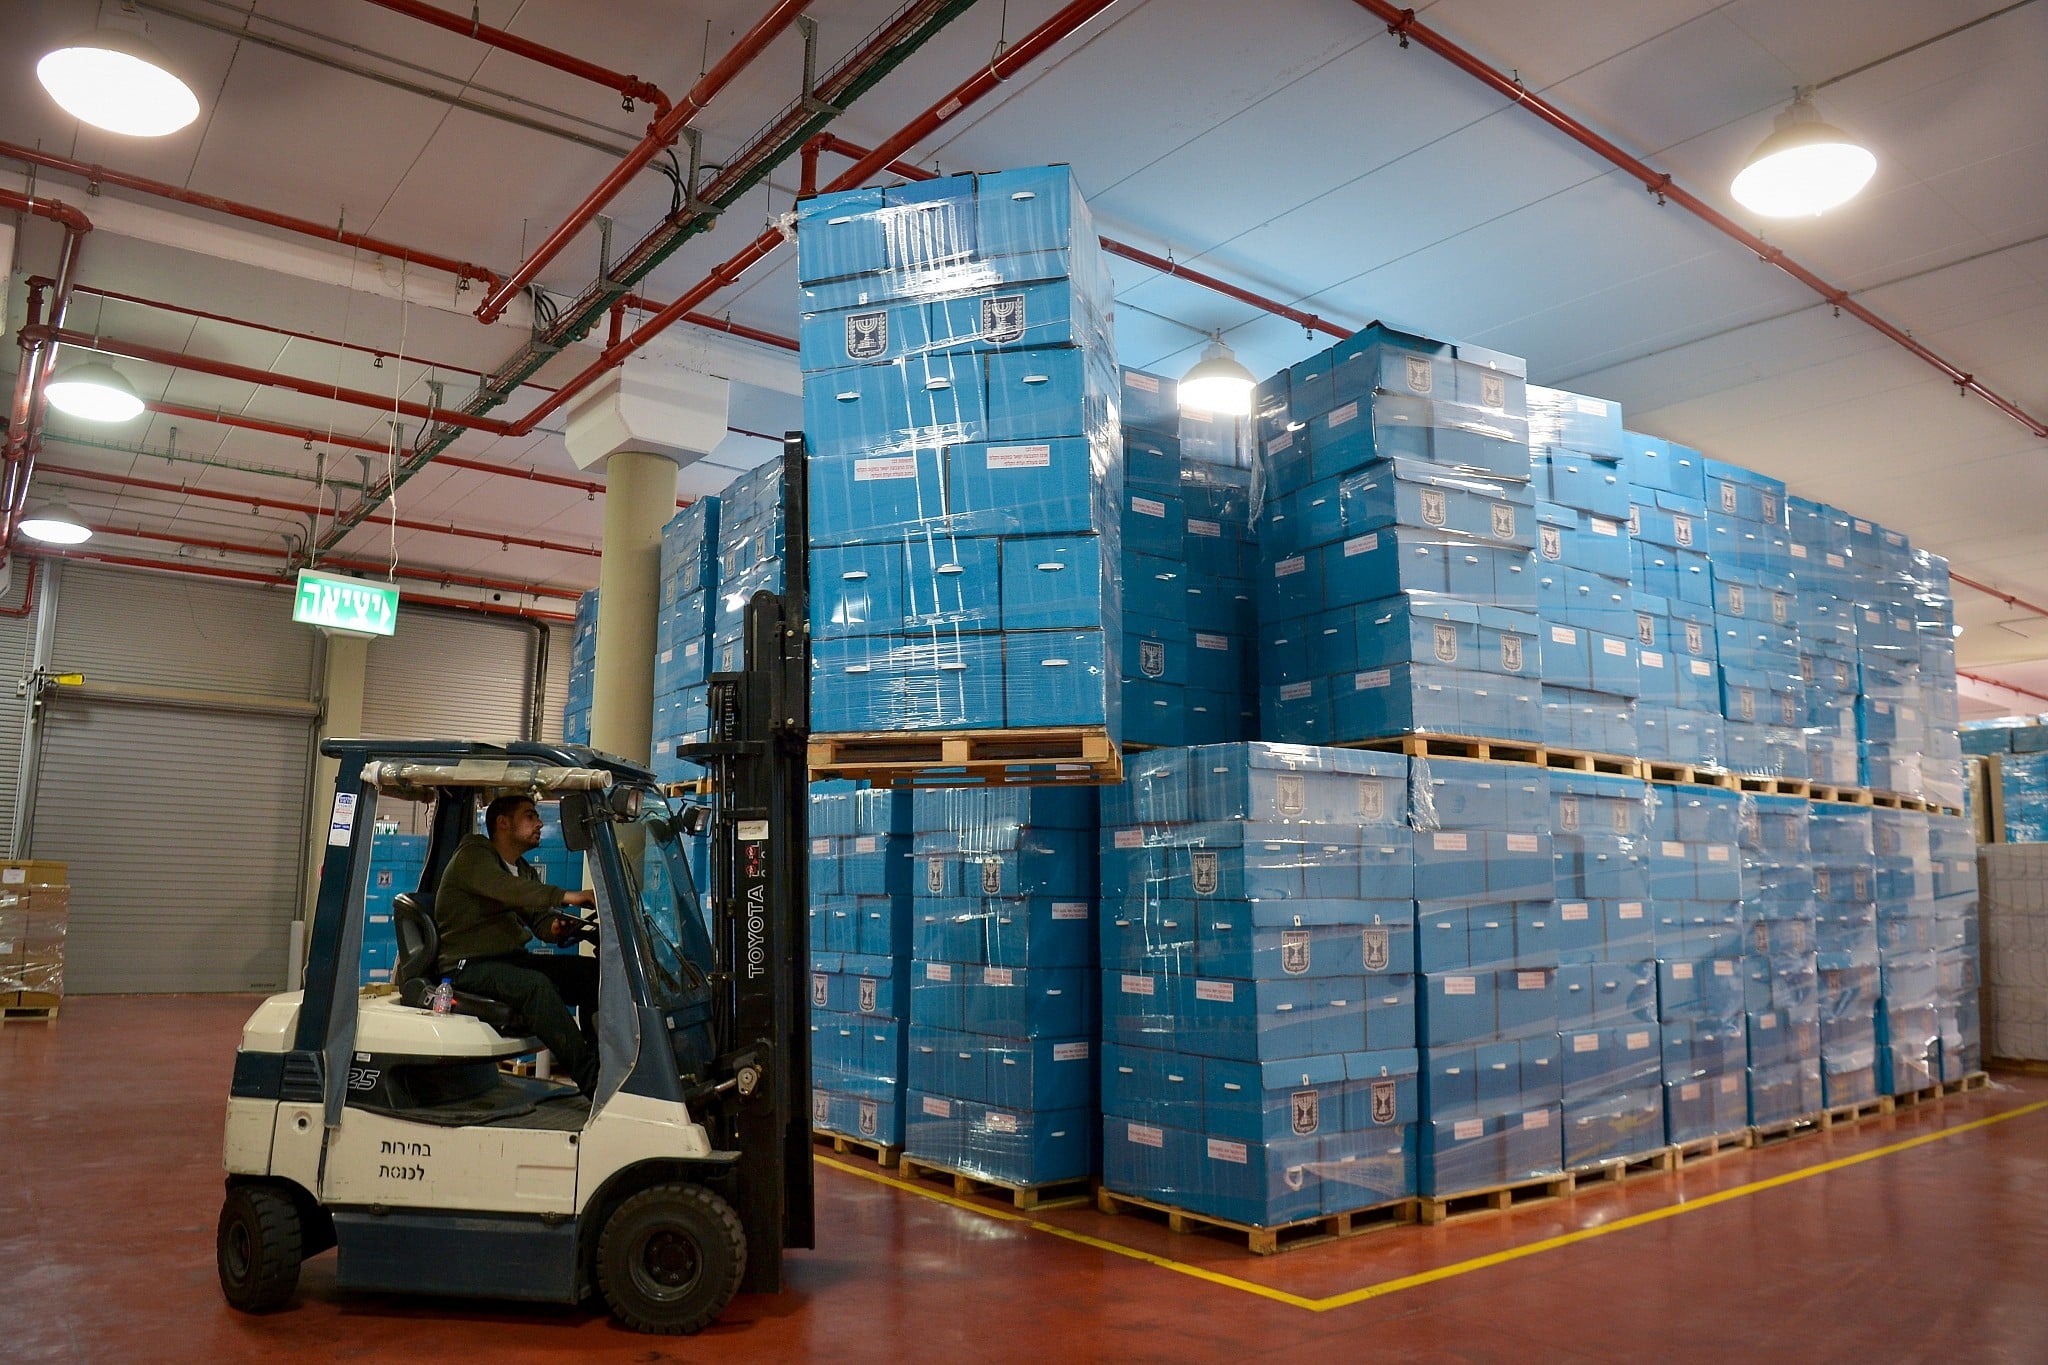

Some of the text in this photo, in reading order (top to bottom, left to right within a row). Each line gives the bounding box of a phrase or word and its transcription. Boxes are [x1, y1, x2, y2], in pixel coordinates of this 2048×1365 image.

[300, 582, 382, 627] יציאה
[747, 884, 765, 979] TOYOTA
[380, 1140, 432, 1157] בחירות
[378, 1163, 425, 1181] לכנסת
